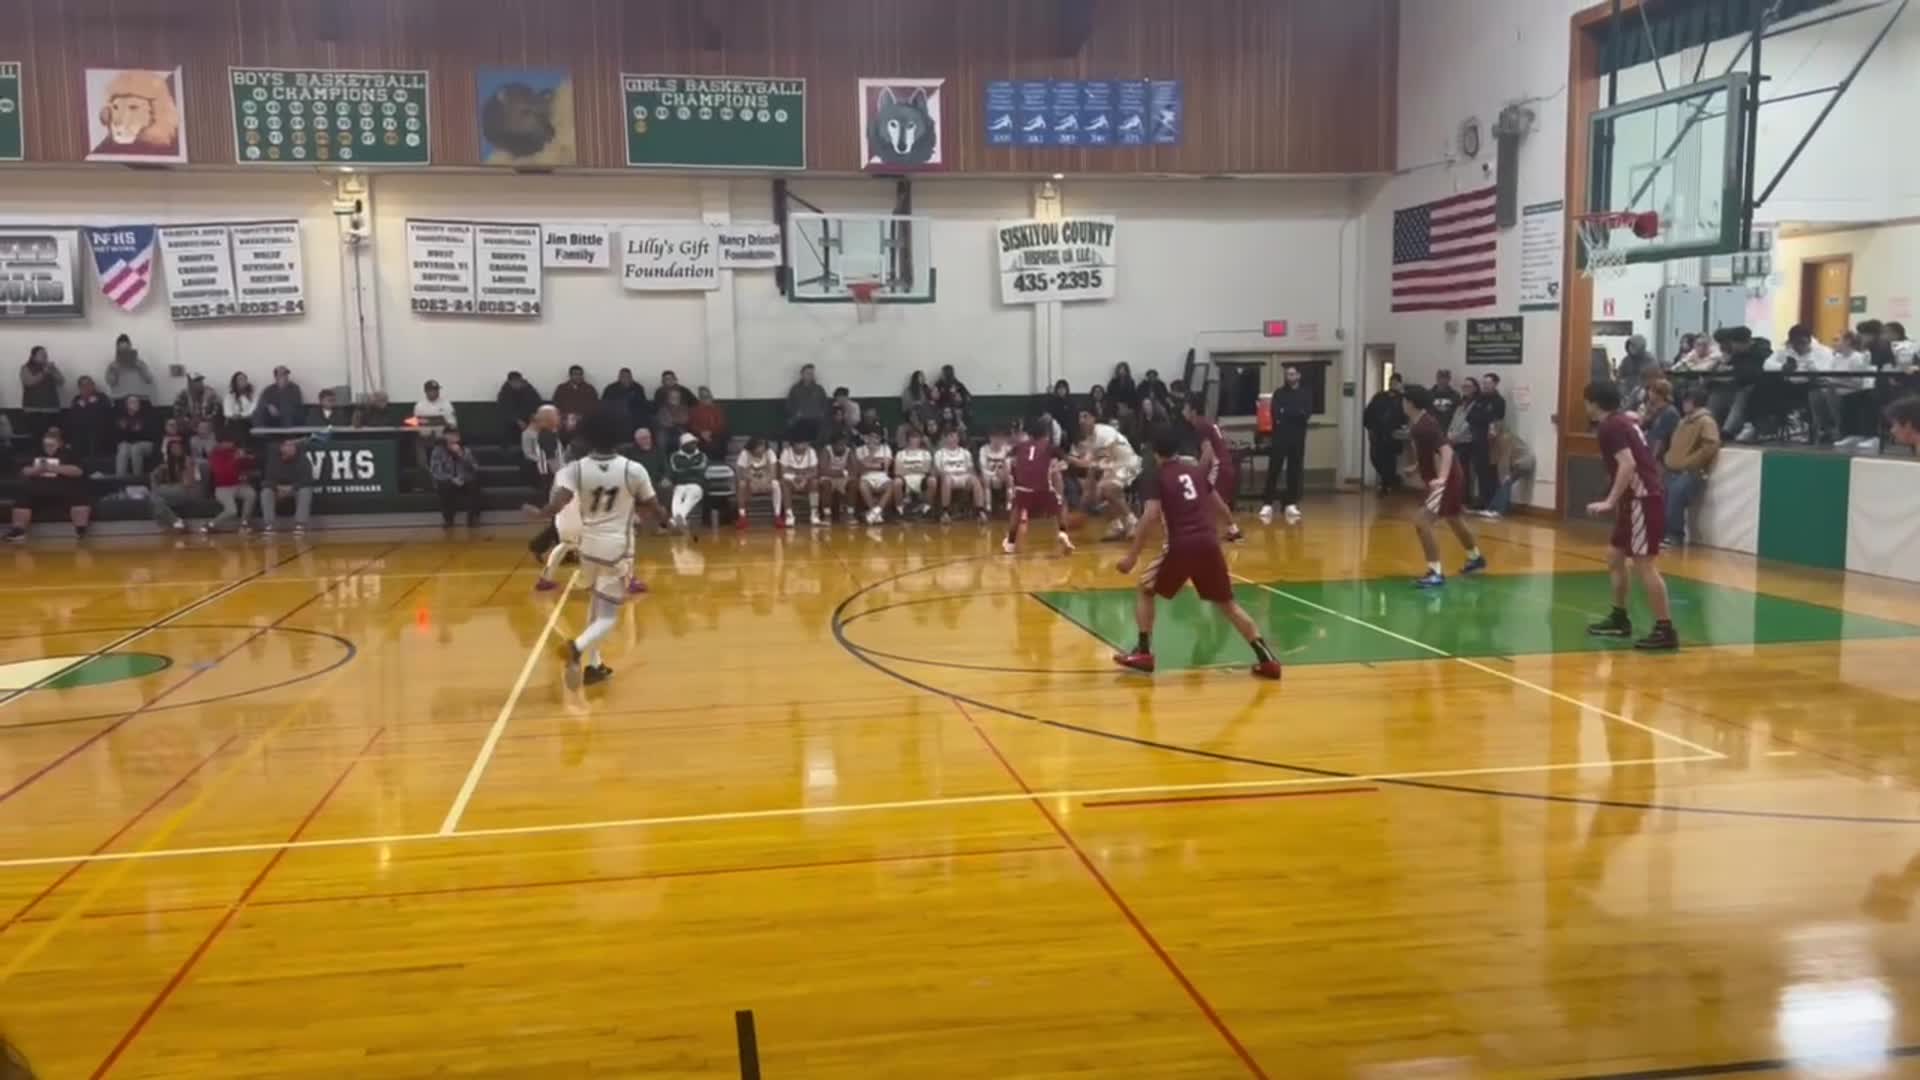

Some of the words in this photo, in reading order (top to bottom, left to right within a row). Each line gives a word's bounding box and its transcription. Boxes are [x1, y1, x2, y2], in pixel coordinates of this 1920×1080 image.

[233, 71, 285, 86] BOYS
[295, 73, 425, 89] BASKETBALL
[625, 78, 677, 93] GIRLS
[685, 80, 803, 95] BASKETBALL
[272, 87, 388, 102] CHAMPIONS
[661, 93, 769, 108] CHAMPIONS
[92, 231, 136, 245] NFHS
[545, 232, 568, 245] Jim
[570, 232, 604, 246] Bittle
[1000, 223, 1059, 253] SISKIYOU
[1062, 220, 1114, 247] COUNTY
[555, 248, 595, 264] Family
[627, 239, 674, 261] Lilly's
[679, 239, 710, 261] Gift
[624, 262, 714, 279] Foundation
[240, 299, 304, 314] 2023-24
[1028, 445, 1036, 461] 1
[1178, 473, 1198, 500] 3
[591, 485, 620, 513] 11
